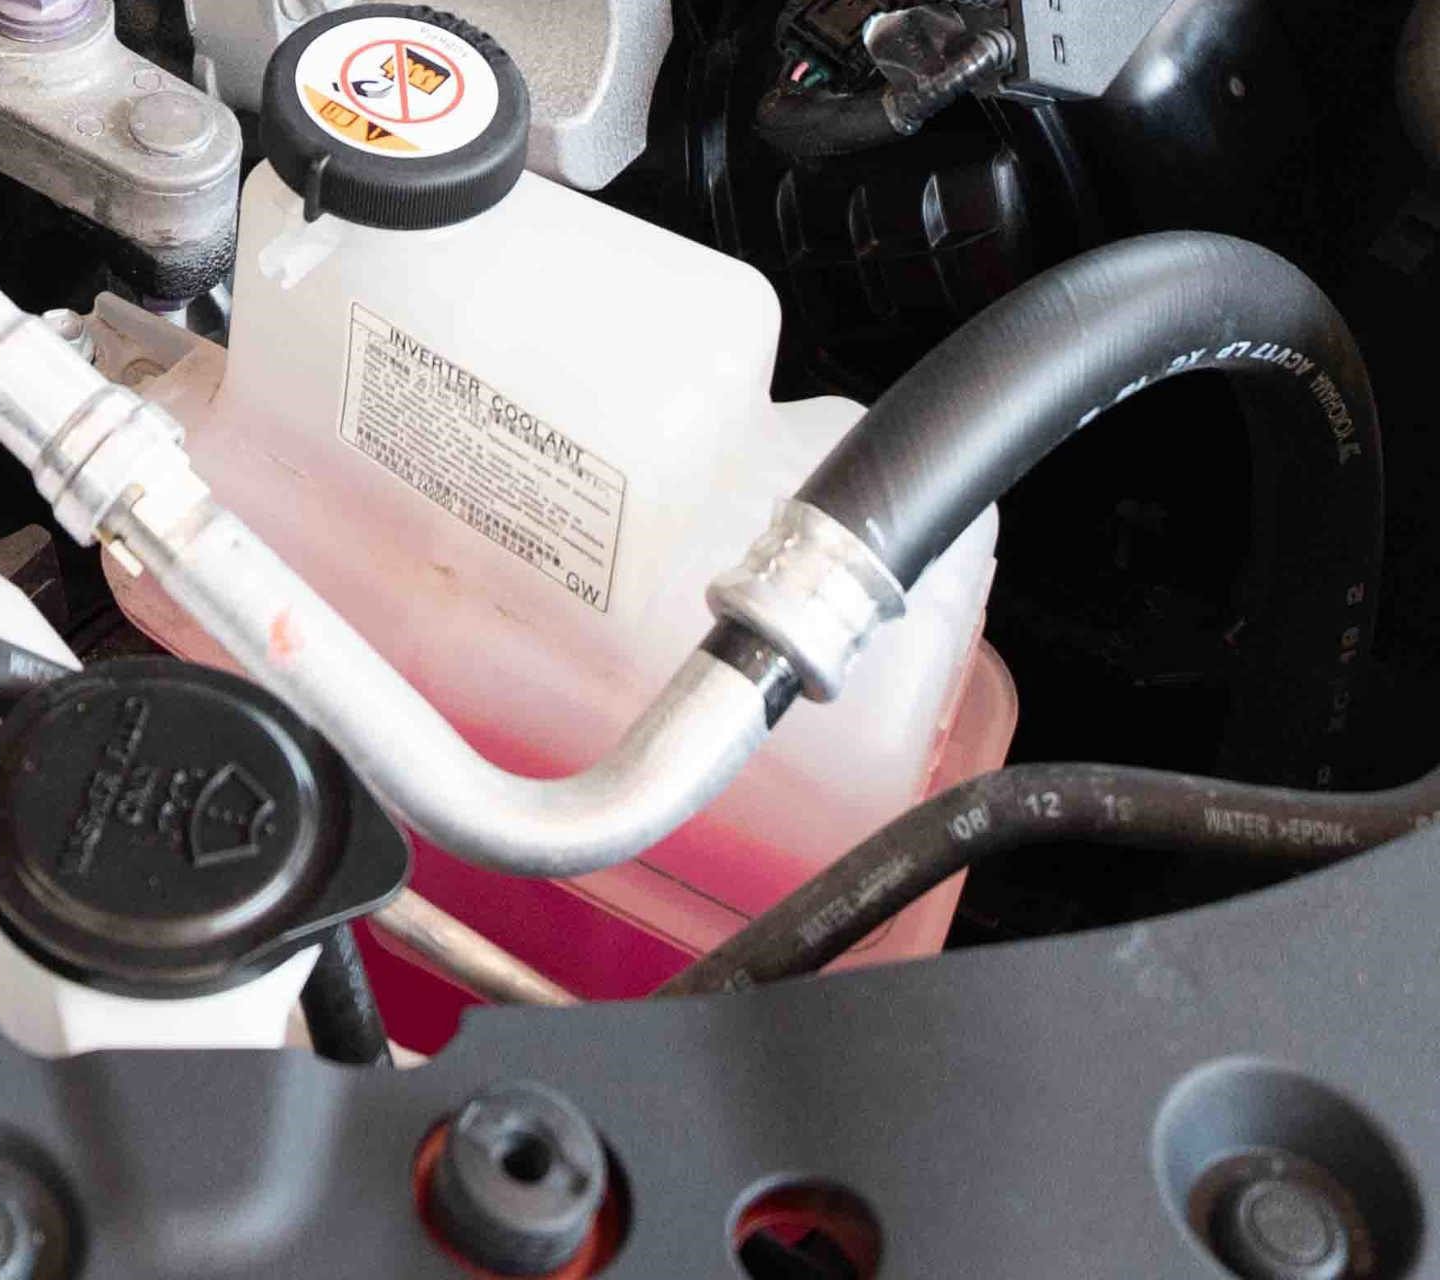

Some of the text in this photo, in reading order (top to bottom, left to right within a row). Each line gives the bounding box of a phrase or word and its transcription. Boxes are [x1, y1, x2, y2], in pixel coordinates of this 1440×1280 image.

[389, 326, 584, 464] INVERTER COOLANT
[566, 570, 601, 606] GW
[1023, 790, 1064, 819] 12
